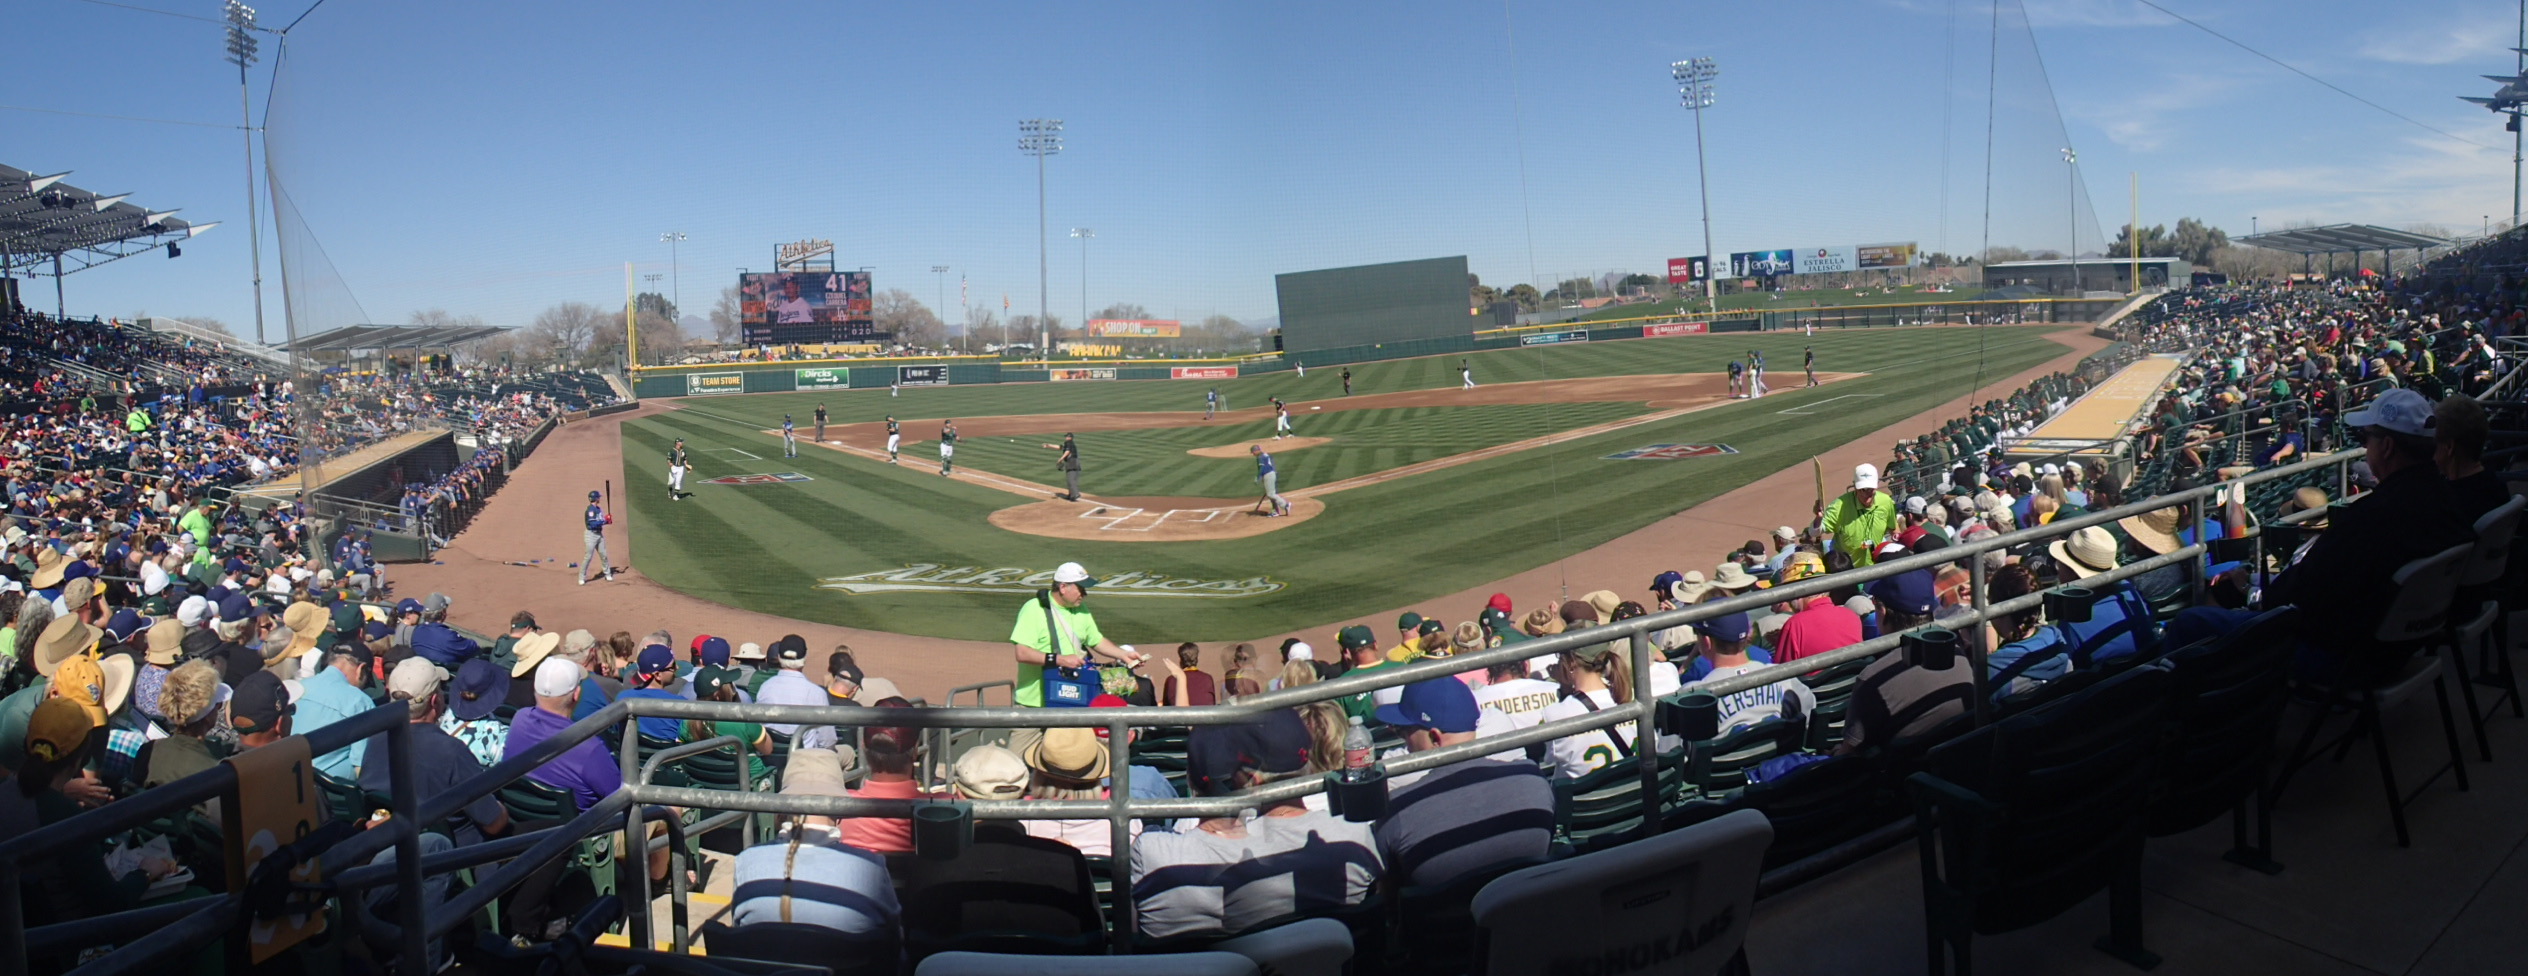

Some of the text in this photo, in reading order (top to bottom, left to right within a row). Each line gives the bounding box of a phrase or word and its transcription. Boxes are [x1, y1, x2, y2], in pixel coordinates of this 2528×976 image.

[1804, 258, 1845, 266] ESTRELLA
[825, 274, 846, 291] 41
[1105, 322, 1128, 334] SHOP
[1128, 322, 1141, 334] ON
[805, 370, 832, 378] Dircks
[702, 376, 741, 386] TEAM STORE
[1061, 684, 1078, 692] BUD
[1058, 690, 1080, 699] LIGHT
